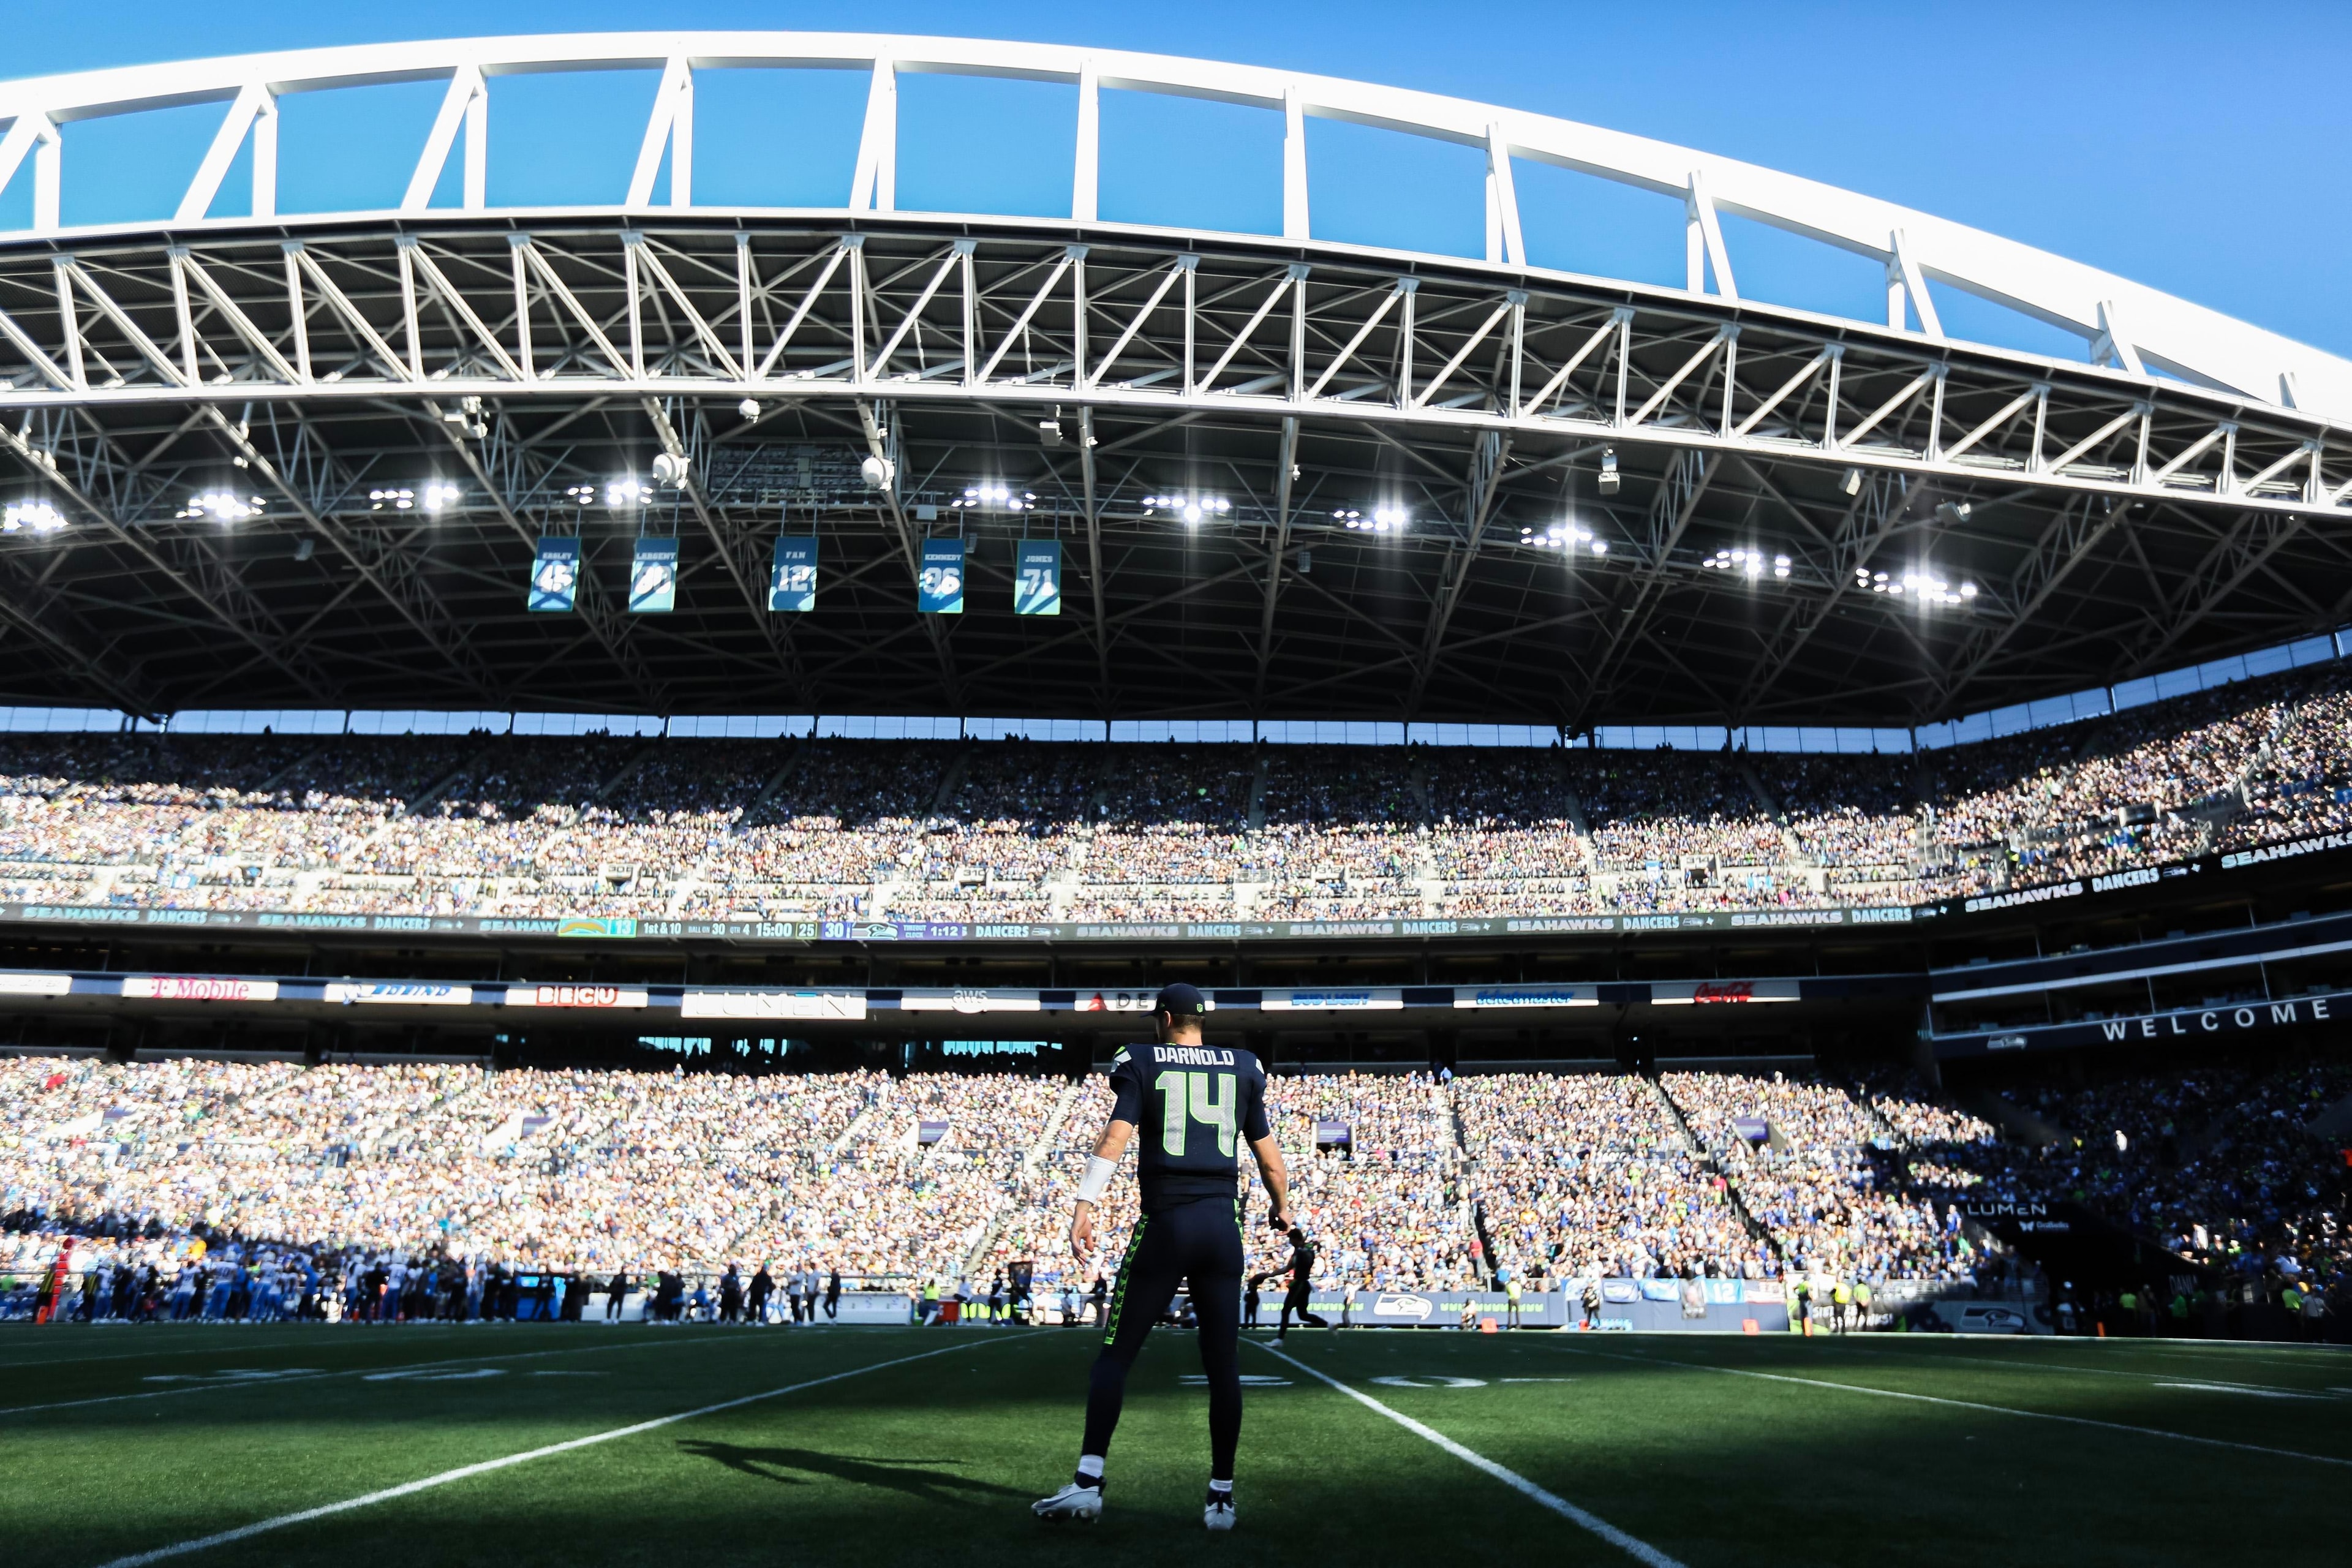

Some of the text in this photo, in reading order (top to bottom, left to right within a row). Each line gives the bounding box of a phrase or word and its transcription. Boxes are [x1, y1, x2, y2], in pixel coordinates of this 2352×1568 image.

[535, 565, 573, 593] 45
[778, 565, 810, 592] 12
[923, 567, 961, 595] 96
[1023, 568, 1055, 596] 71
[1966, 867, 2160, 913] SEAHAWKS DANCERS
[23, 907, 208, 924] SEAHAWKS DANCERS
[258, 914, 430, 930] SEAHAWKS DANCERS
[1731, 907, 1912, 927] SEAHAWKS DANCERS
[616, 919, 631, 935] 13
[644, 922, 682, 935] 1st & 10
[712, 923, 725, 935] 30
[743, 924, 750, 935] 4
[756, 922, 792, 937] 15:00
[799, 923, 815, 937] 25
[824, 923, 843, 938] 30
[930, 926, 958, 937] 1:12
[976, 925, 1030, 938] DANCERS
[1077, 925, 1241, 937] SEAHAWKS DANCERS
[1290, 922, 1457, 936] SEAHAWKS DANCERS
[1507, 916, 1679, 932] SEAHAWKS DANCERS
[537, 985, 617, 1006] BECU
[2102, 999, 2330, 1041] WELCOME
[1153, 1046, 1235, 1066] DARNOLD
[1155, 1071, 1237, 1158] 14
[1967, 1203, 2047, 1216] LUMEN
[1713, 1282, 1737, 1303] 12
